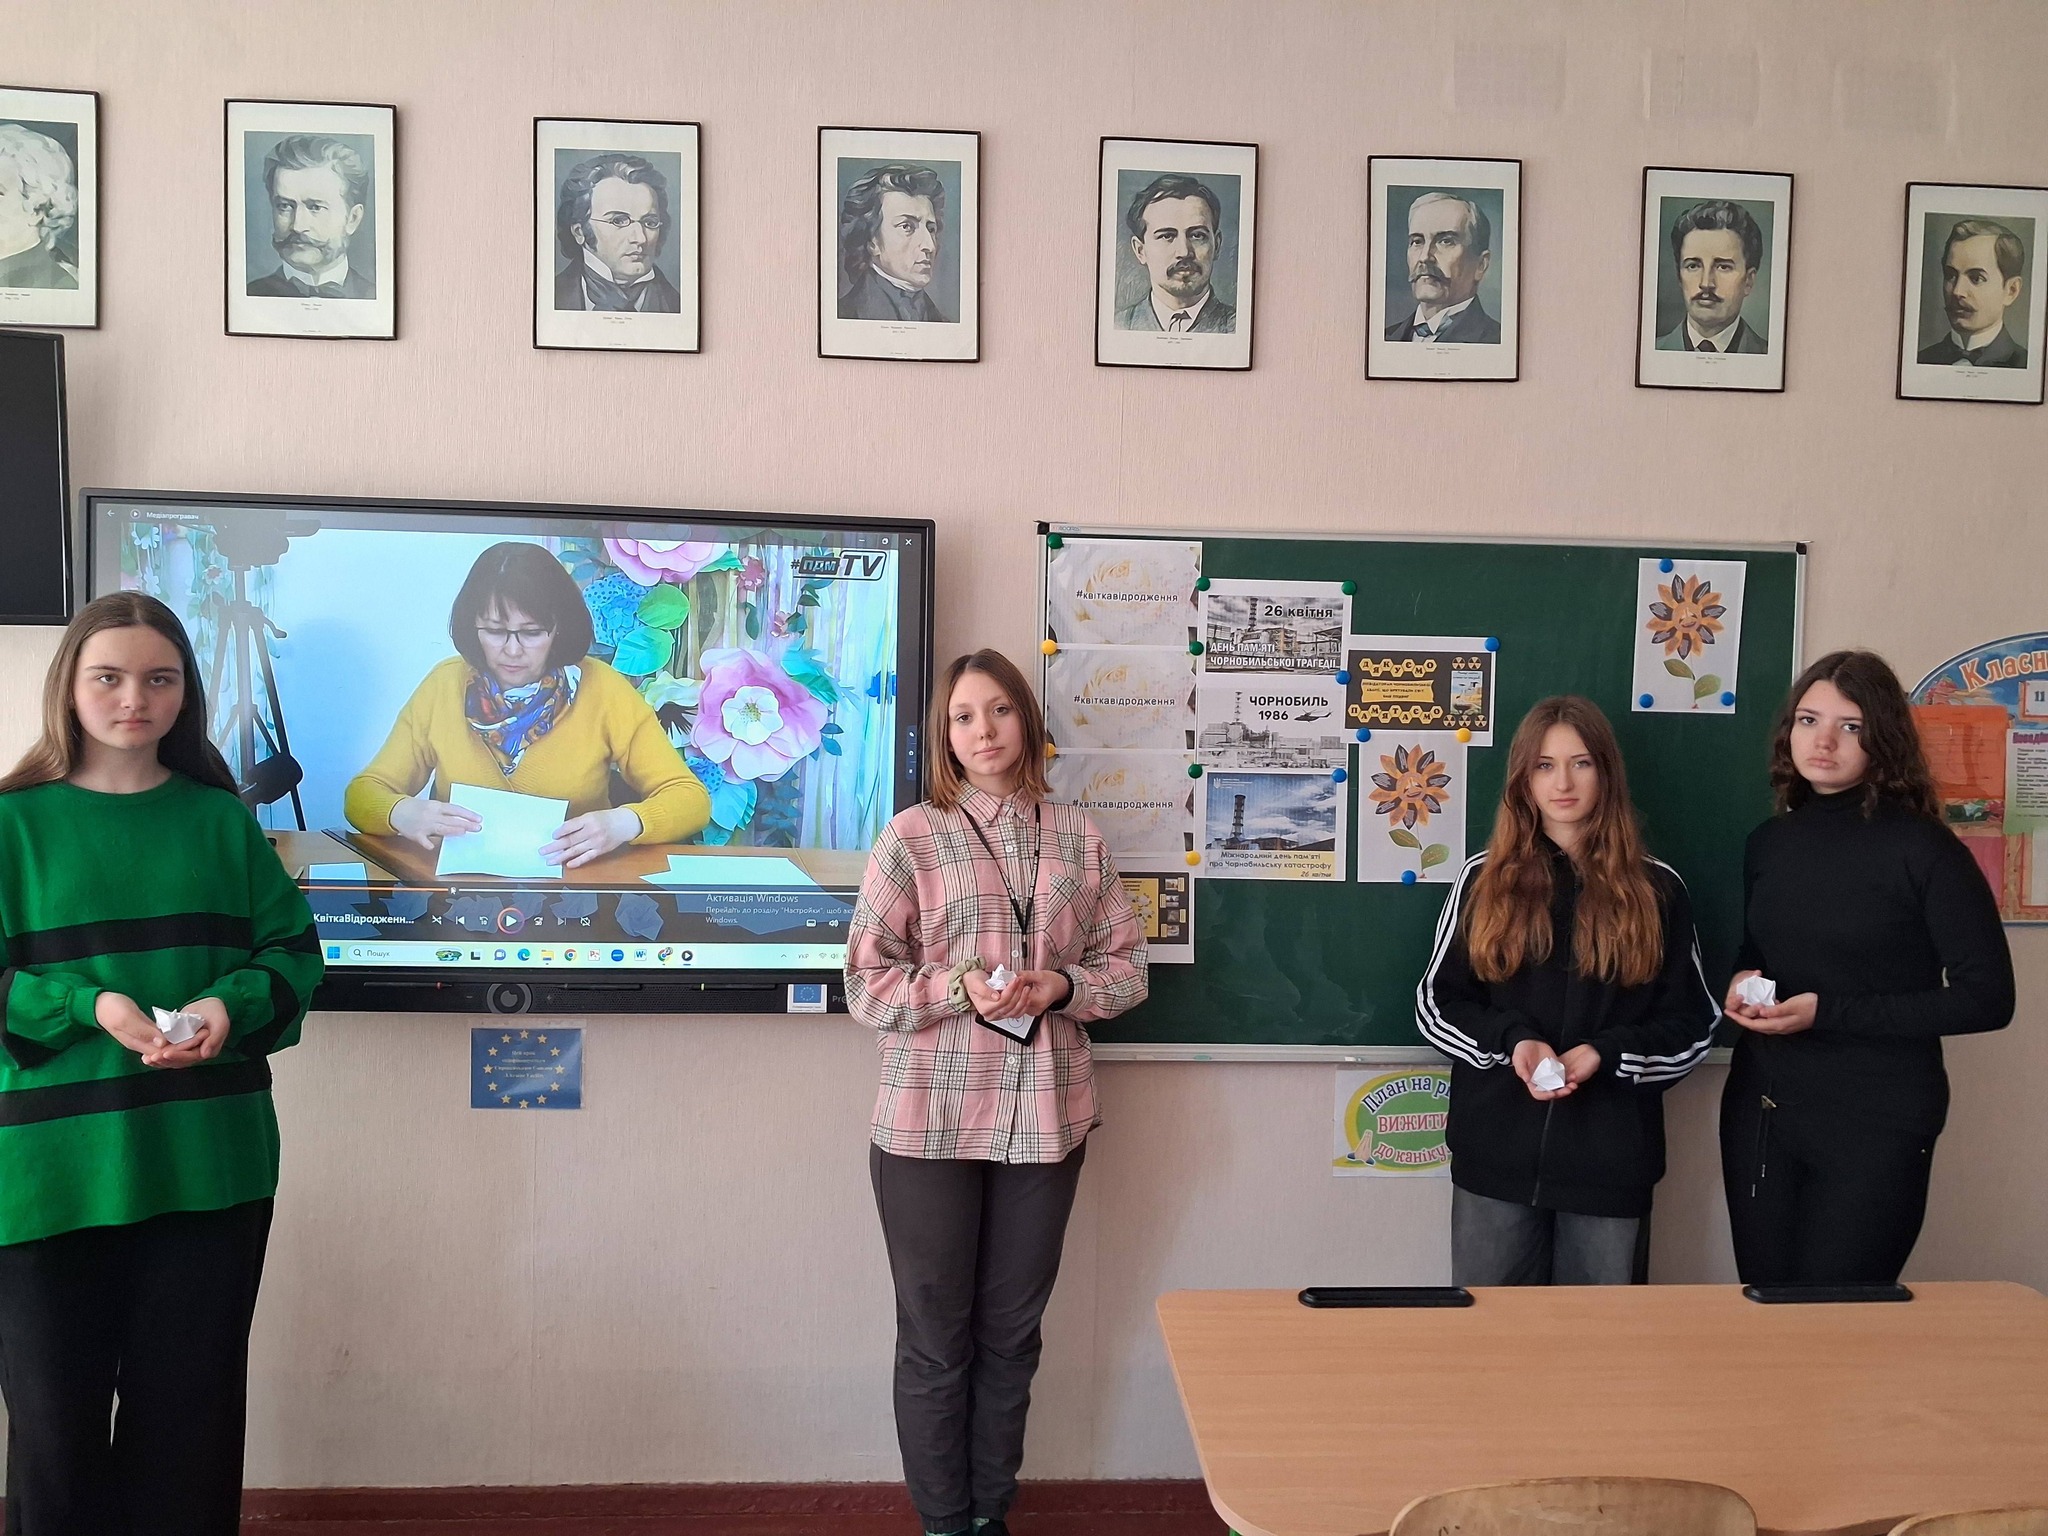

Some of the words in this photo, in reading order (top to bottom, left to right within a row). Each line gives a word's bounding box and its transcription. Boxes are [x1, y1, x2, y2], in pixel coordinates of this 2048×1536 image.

[843, 554, 884, 577] TV
[1076, 589, 1179, 602] #квіткавідродження
[1264, 605, 1283, 617] 26
[1288, 606, 1333, 618] квітня
[1210, 642, 1235, 652] ДЕНЬ
[1959, 650, 2048, 693] Класн
[1073, 695, 1175, 706] #квіткавідродження
[1249, 696, 1329, 707] ЧОРНОБИЛЬ
[1258, 710, 1289, 721] 1986
[1072, 799, 1174, 810] #квіткавідродження
[1220, 851, 1272, 860] Міжнародний
[1209, 860, 1224, 868] про
[1225, 860, 1282, 869] Чорнобильську
[1283, 862, 1332, 870] катастрофу
[1300, 870, 1310, 878] 26
[706, 893, 754, 904] Активація
[755, 893, 799, 903] Windows
[366, 949, 391, 958] Пошук
[1362, 1078, 1408, 1113] План
[1411, 1076, 1432, 1092] на
[1375, 1143, 1394, 1159] до
